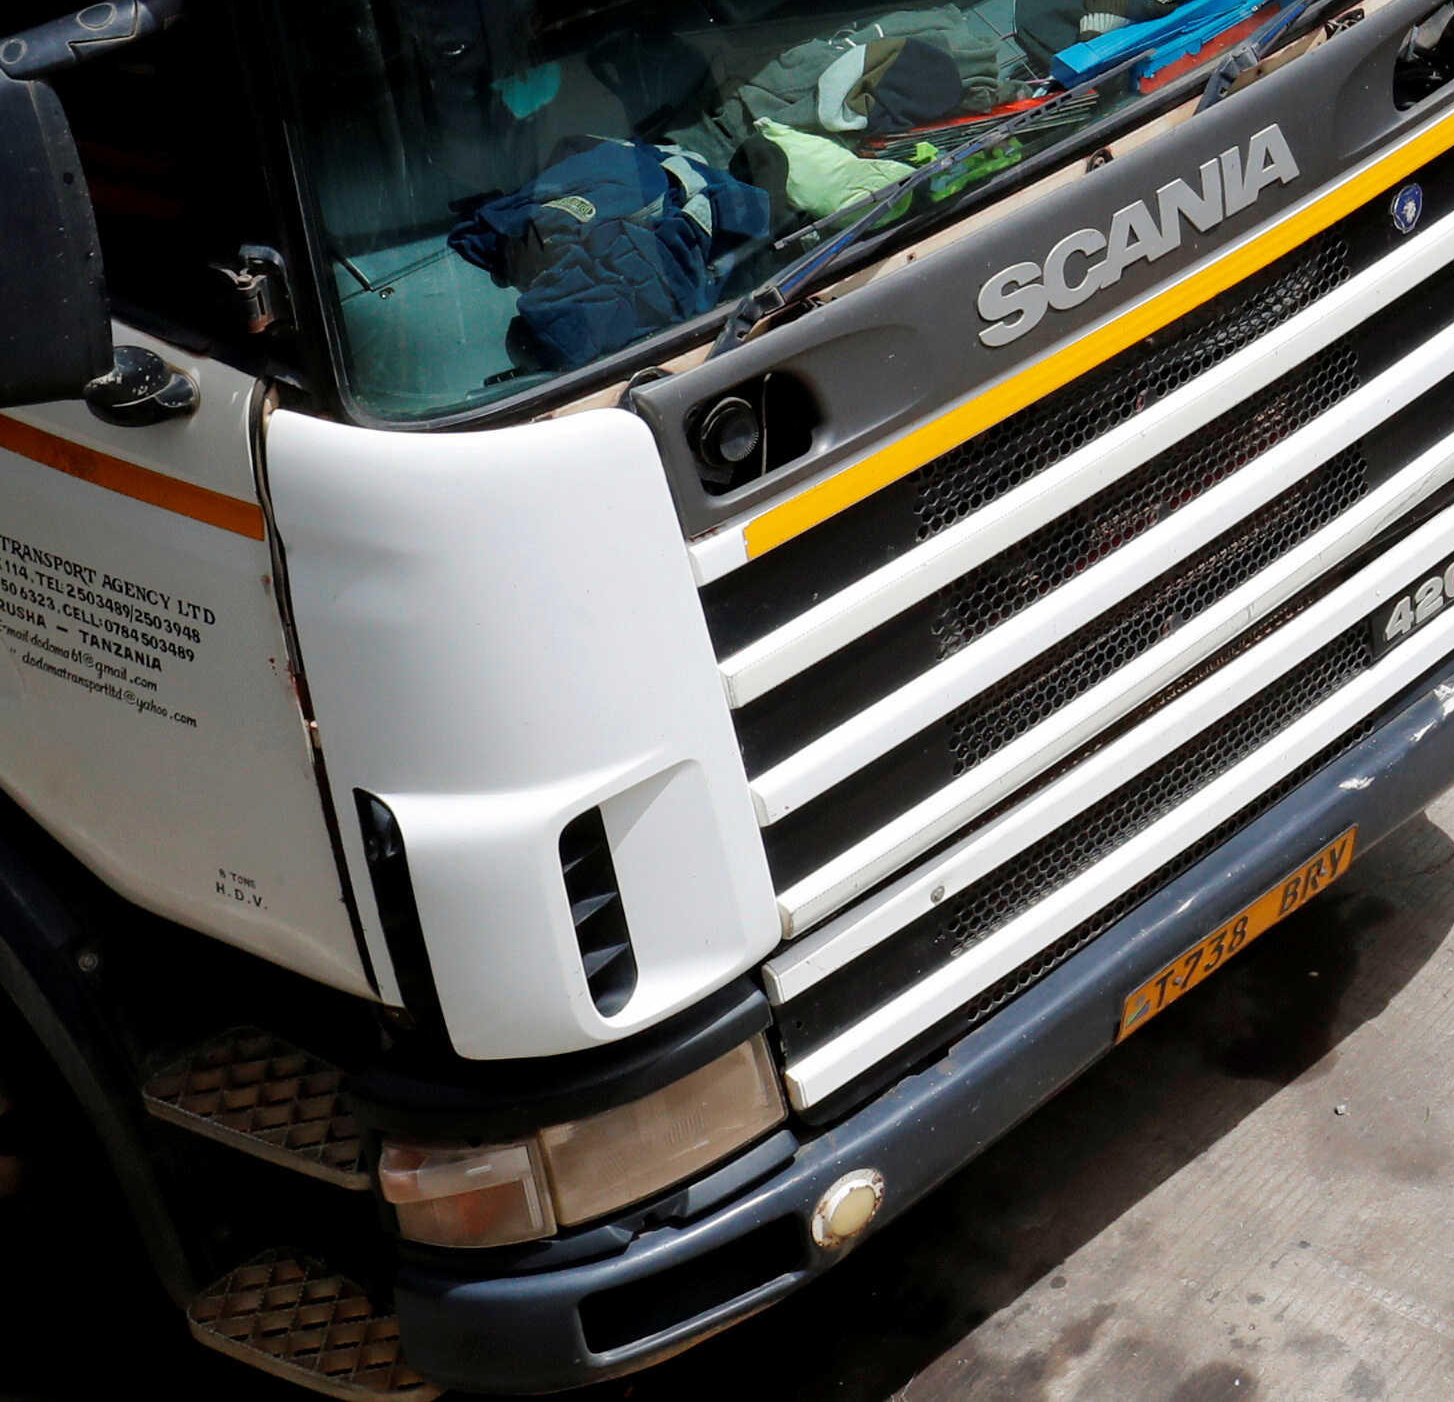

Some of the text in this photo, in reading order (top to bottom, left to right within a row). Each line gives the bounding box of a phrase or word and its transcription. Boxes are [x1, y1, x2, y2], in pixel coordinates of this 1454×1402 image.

[976, 122, 1300, 348] SCANIA
[0, 534, 217, 626] TRANSPORT AGENCY LTD
[78, 629, 163, 672] TANZANIA
